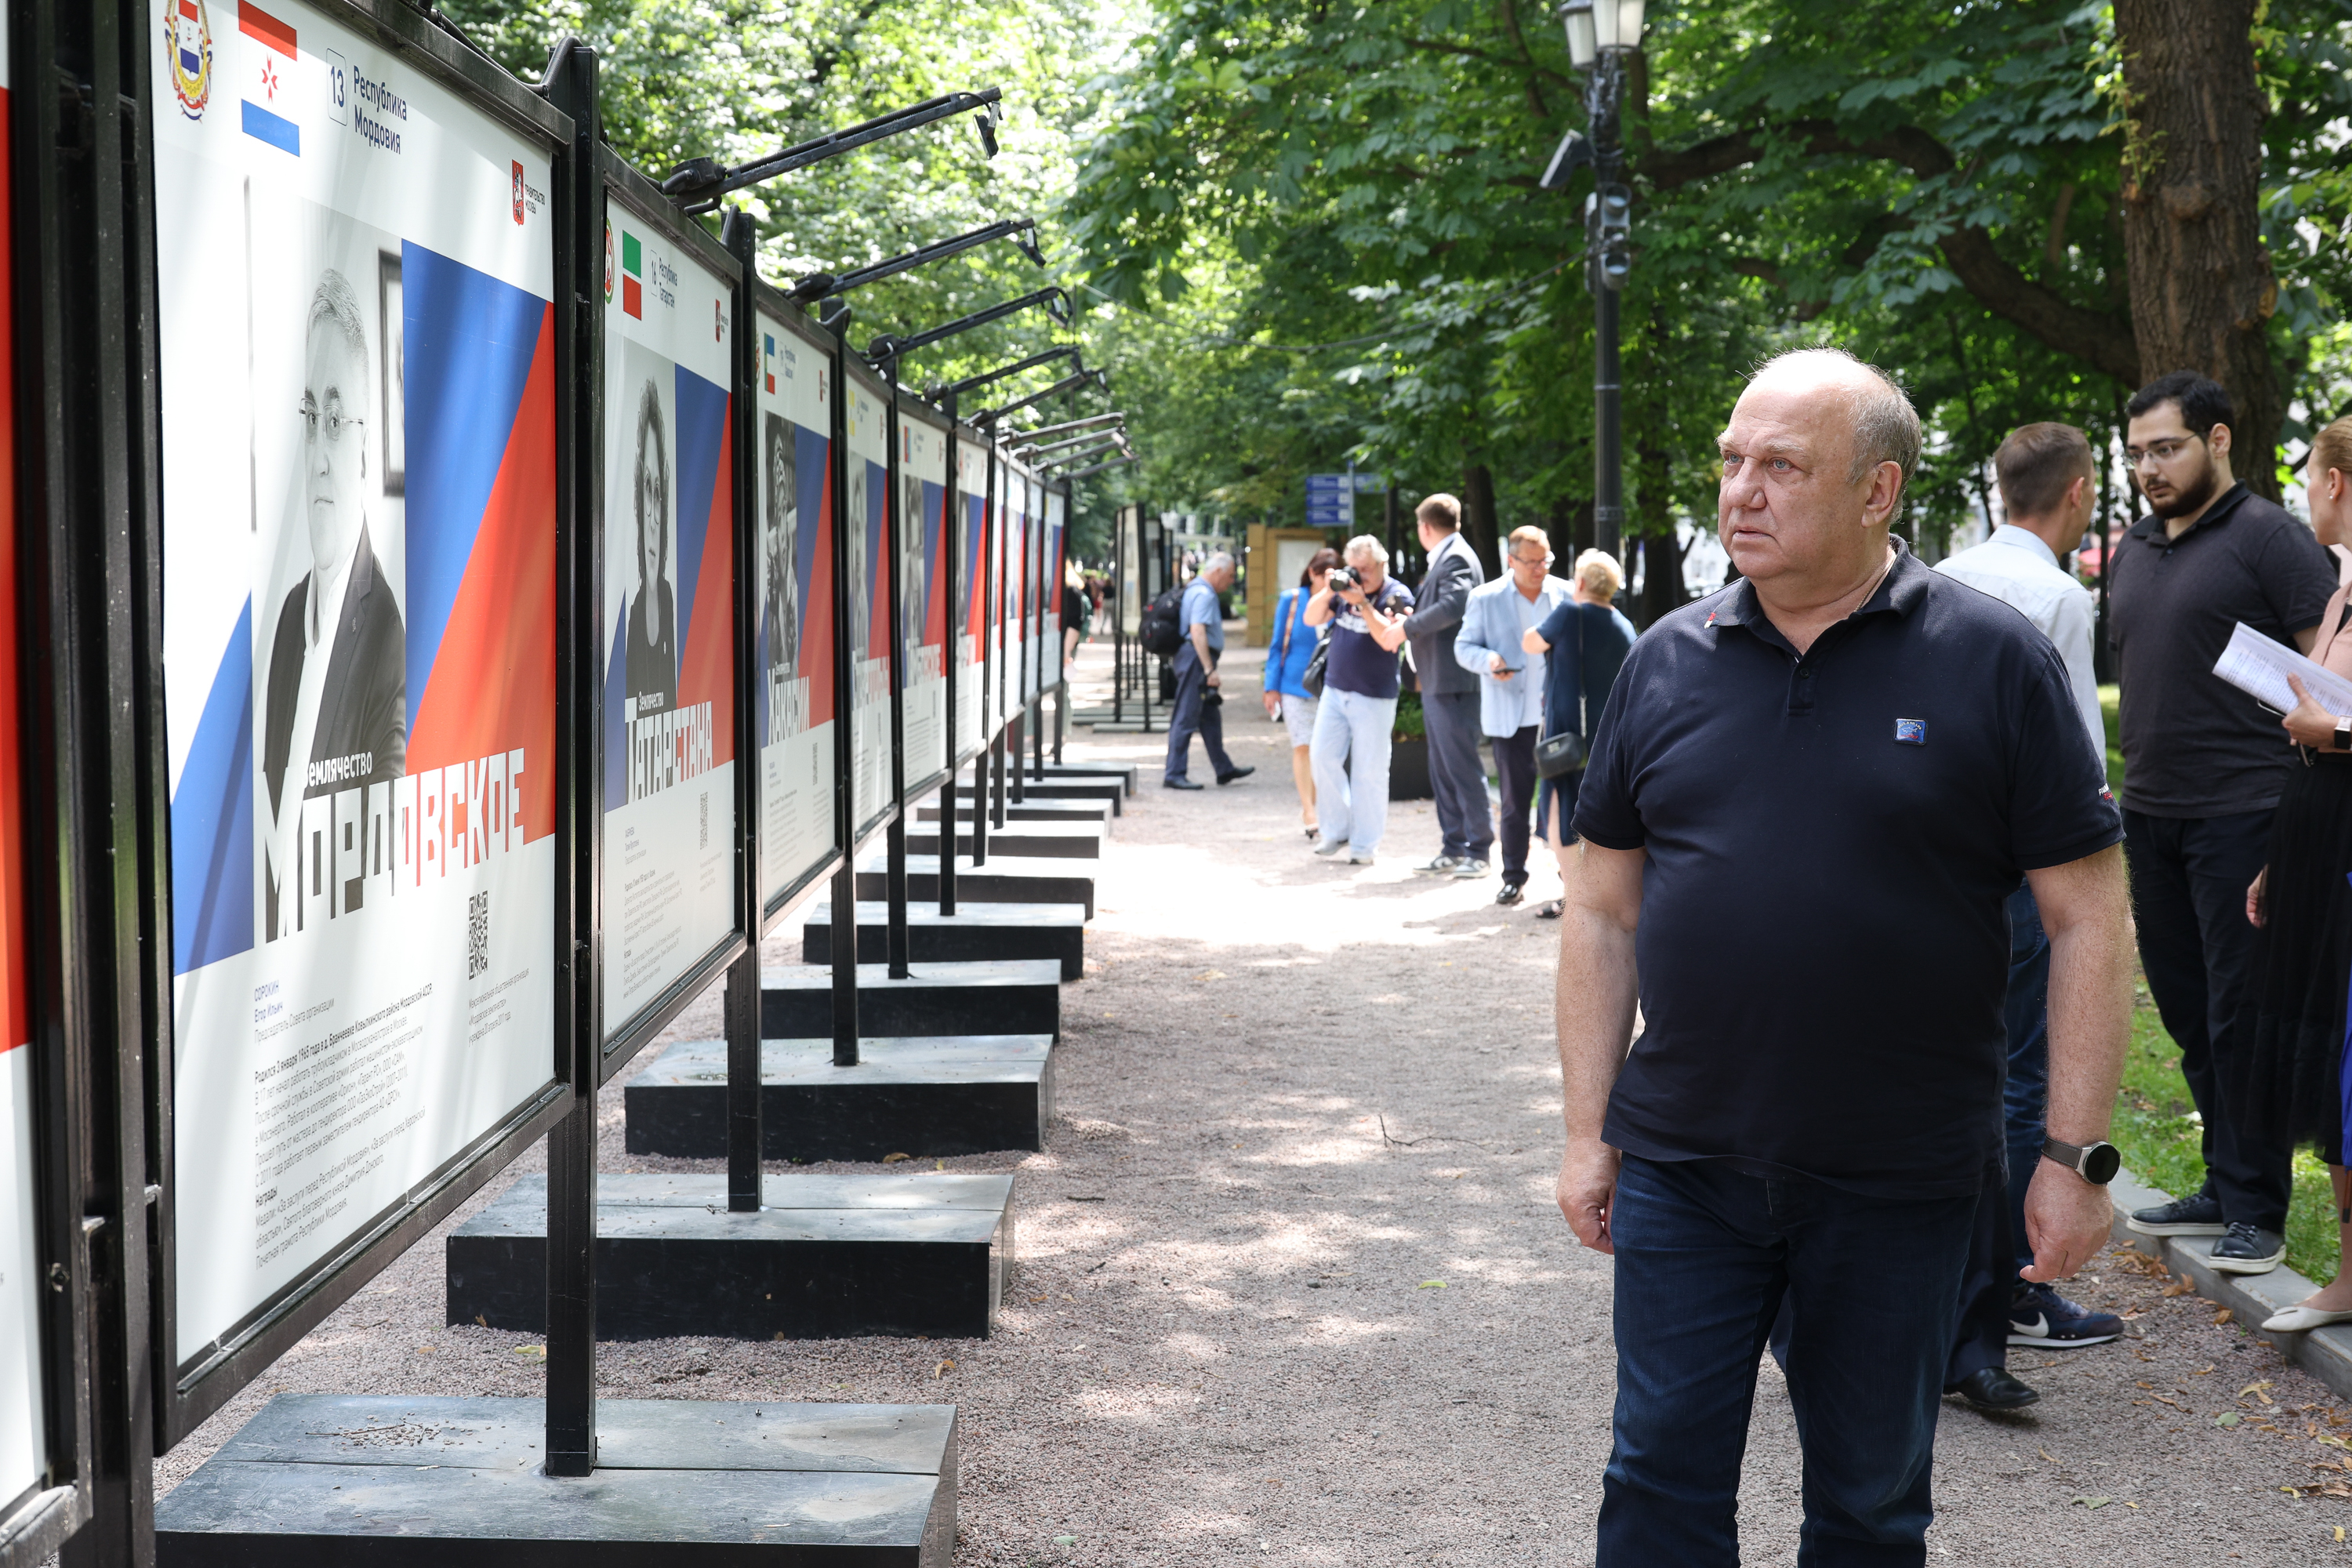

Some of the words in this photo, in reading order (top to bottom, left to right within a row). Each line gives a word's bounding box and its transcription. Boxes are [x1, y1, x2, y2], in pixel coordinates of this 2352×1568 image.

[331, 66, 344, 107] 13
[354, 65, 407, 121] Республика
[354, 104, 401, 154] Мордовия
[524, 183, 546, 206] ПРАВИТЕЛЬСТВО
[524, 198, 537, 214] МОСКВЫ
[652, 260, 656, 285] 16
[659, 257, 678, 287] Республика
[659, 282, 675, 308] Татарстан
[638, 691, 664, 712] Землячество
[302, 751, 373, 788] емлячество
[254, 978, 278, 1002] СОРОКИН
[254, 1008, 266, 1023] Егор
[267, 1000, 282, 1017] Ильич
[254, 1018, 288, 1045] Председатель
[289, 1010, 305, 1027] Совета
[306, 996, 334, 1021] организации
[255, 1065, 275, 1085] Родился
[277, 1059, 279, 1073] 3
[281, 1054, 297, 1072] января
[299, 1044, 309, 1062] 1965
[310, 1042, 319, 1057] года
[321, 1040, 323, 1051] в
[324, 1039, 328, 1052] д.
[329, 1025, 354, 1048] Бранчеевке
[355, 1009, 385, 1033] Ковылкинского
[386, 1001, 399, 1019] района
[400, 987, 422, 1010] Мордовской
[423, 982, 433, 997] АССР.
[255, 1091, 258, 1105] В
[260, 1087, 265, 1103] 17
[276, 1078, 289, 1094] начал
[290, 1067, 310, 1090] работать
[311, 1047, 347, 1077] трубоукладчиком
[347, 1045, 350, 1055] в
[351, 1025, 389, 1054] Мосводоканалстрое
[390, 1023, 392, 1033] в
[393, 1016, 407, 1031] Москве.
[255, 1109, 270, 1127] После
[271, 1094, 290, 1120] срочной
[291, 1085, 308, 1106] службы
[309, 1085, 312, 1096] в
[313, 1069, 335, 1094] Советской
[336, 1065, 349, 1083] армии
[350, 1056, 365, 1076] работал
[366, 1024, 423, 1064] машинистом-экскаваторщиком
[255, 1136, 258, 1147] в
[259, 1122, 285, 1145] Мосэнерго.
[287, 1109, 305, 1129] Работал
[307, 1106, 309, 1117] в
[310, 1091, 337, 1115] кооперативе
[255, 1147, 274, 1170] Прошел
[276, 1140, 285, 1157] путь
[287, 1137, 292, 1149] от
[292, 1125, 310, 1145] мастера
[311, 1122, 317, 1137] до
[318, 1104, 346, 1130] гендиректора
[347, 1094, 356, 1112] ООО
[255, 1174, 259, 1189] С
[260, 1166, 270, 1185] 2011
[272, 1162, 282, 1178] года
[284, 1149, 303, 1174] работает
[304, 1138, 321, 1158] первым
[322, 1120, 351, 1146] заместителем
[352, 1103, 378, 1128] гендиректора
[379, 1096, 384, 1111] АО
[385, 1088, 401, 1108] «ДРСУ».
[256, 1209, 275, 1230] Медали:
[277, 1199, 285, 1214] «За
[287, 1189, 304, 1209] заслуги
[305, 1179, 318, 1196] перед
[319, 1157, 346, 1187] Республикой
[379, 1130, 393, 1147] заслуги
[394, 1122, 405, 1137] перед
[405, 1105, 425, 1130] Херсонской
[255, 1186, 277, 1210] Награды
[283, 1210, 301, 1232] Святого
[302, 1189, 331, 1218] благоверного
[332, 1181, 343, 1197] князя
[344, 1167, 365, 1191] Димитрия
[365, 1155, 383, 1177] Донского.
[256, 1246, 278, 1271] Почетная
[280, 1232, 298, 1255] грамота
[299, 1213, 325, 1240] Республики
[325, 1199, 347, 1221] Мордовия.
